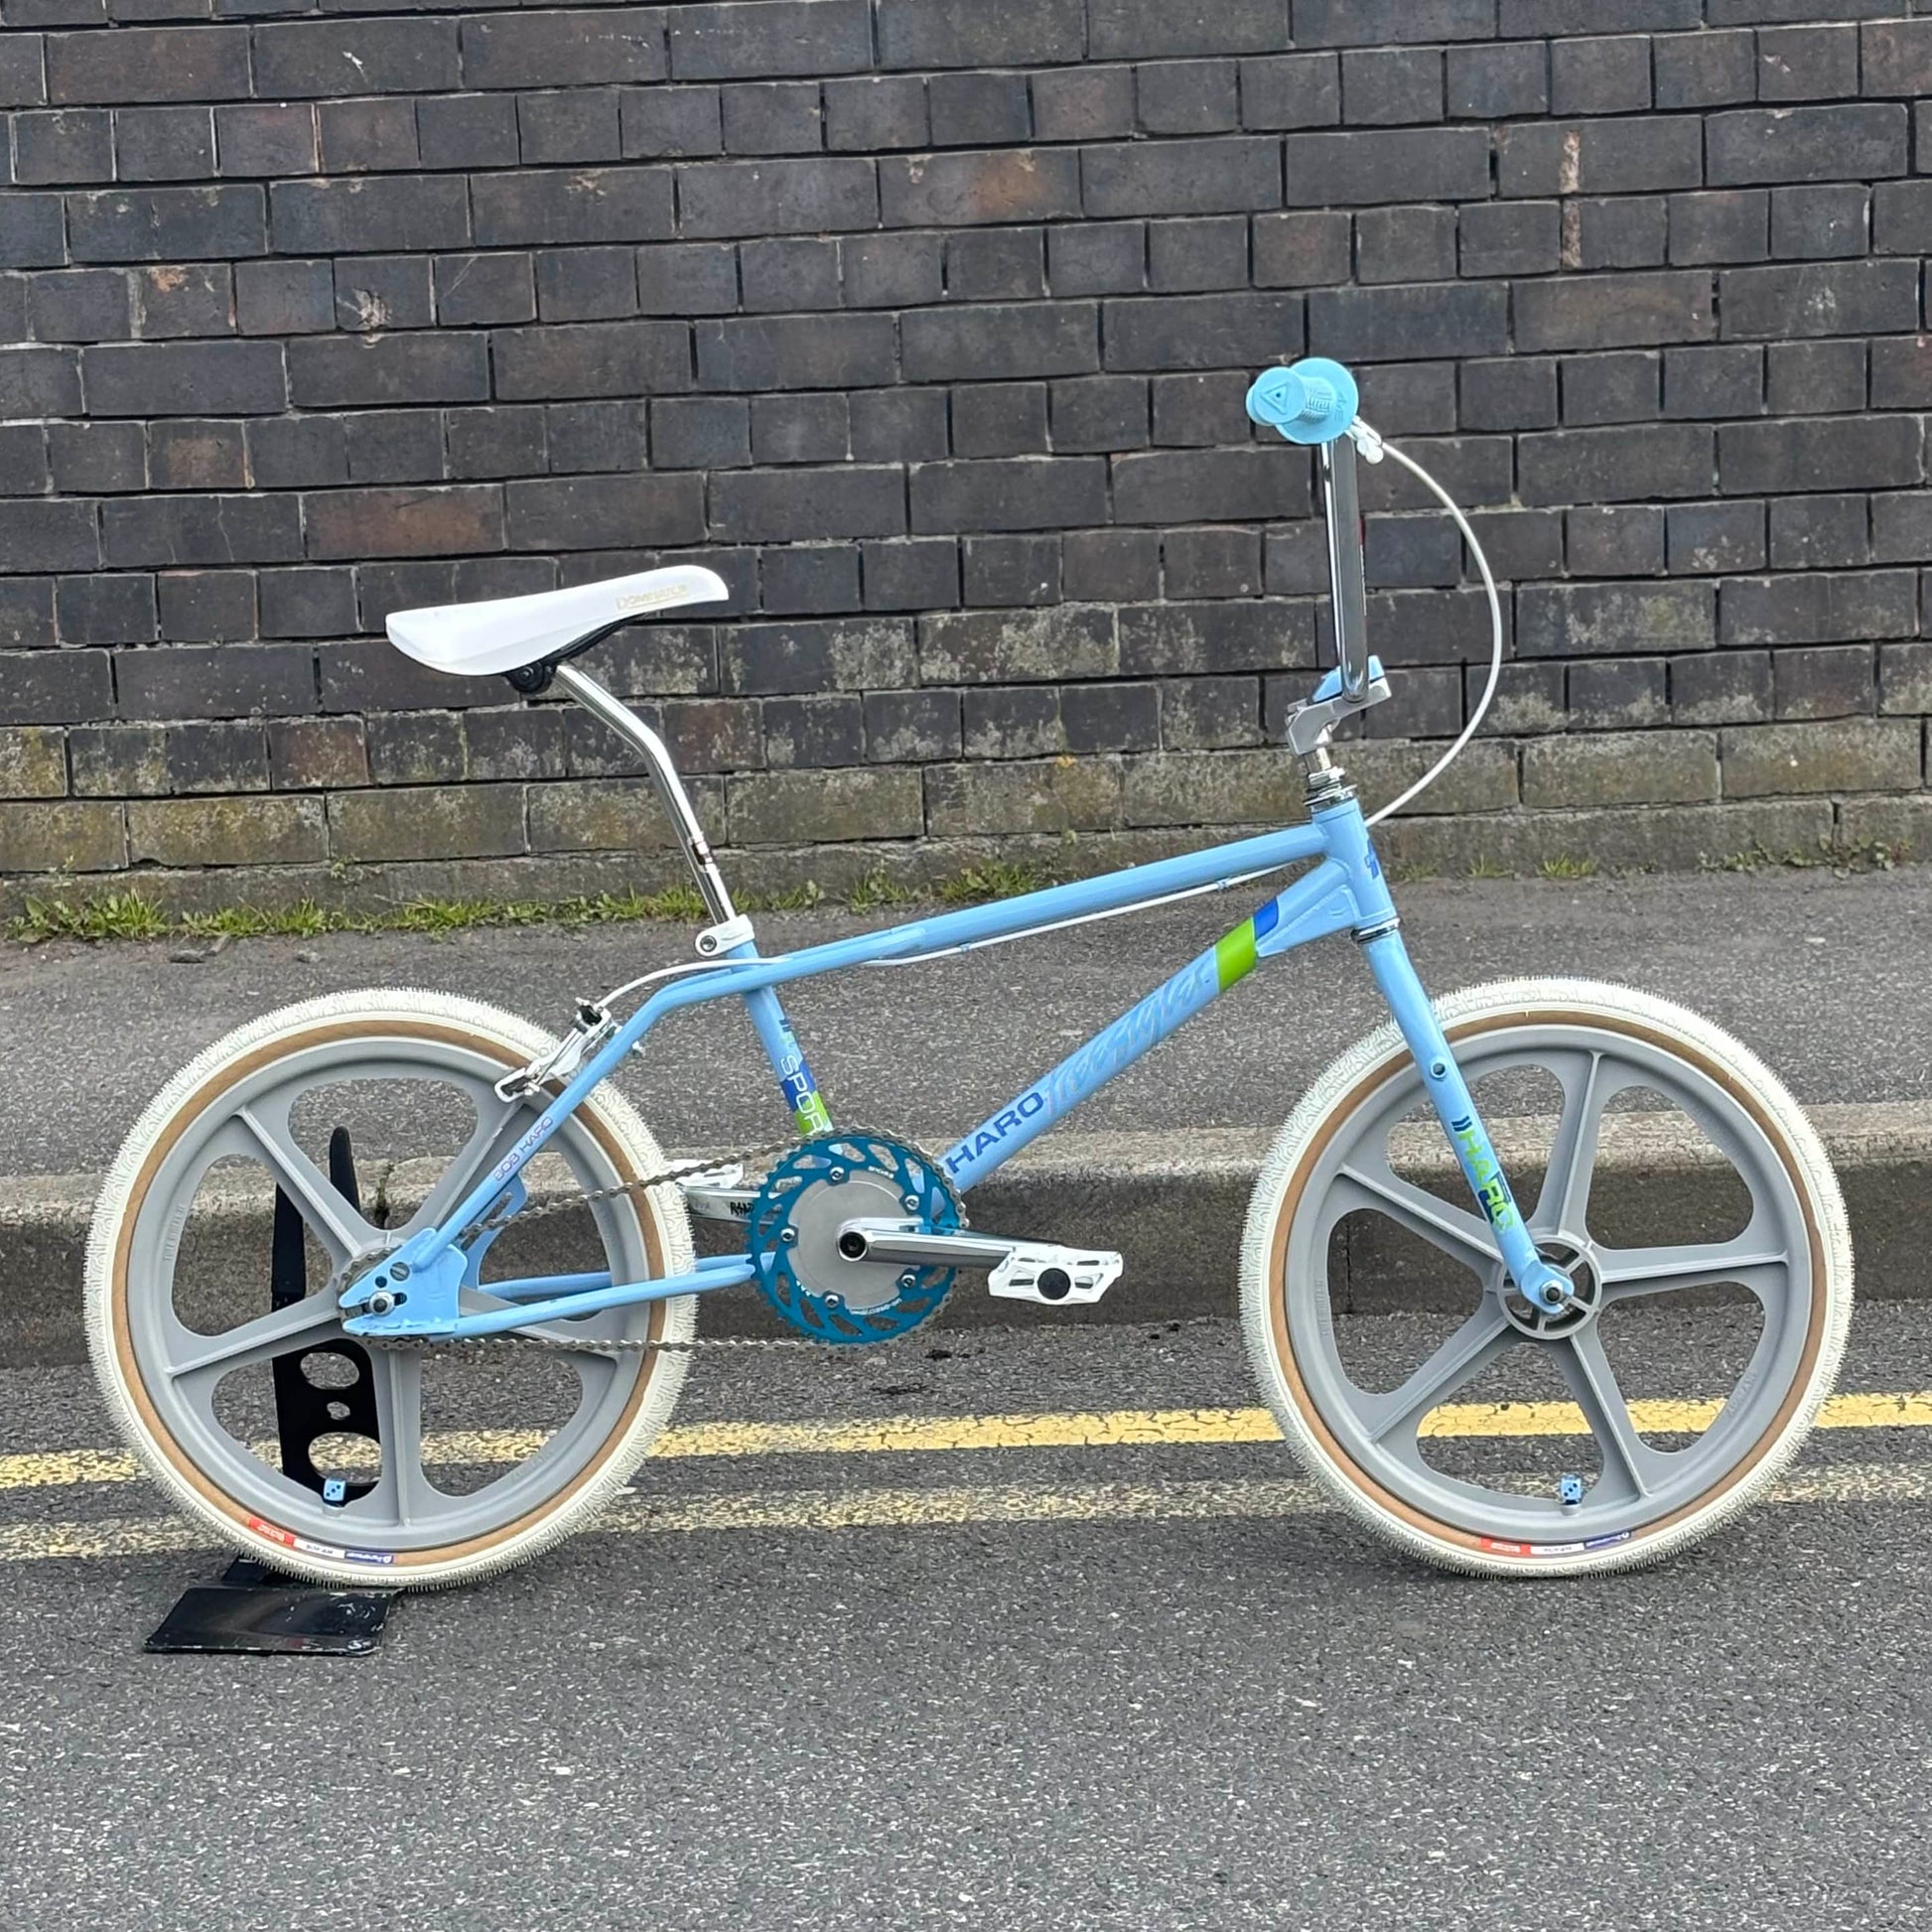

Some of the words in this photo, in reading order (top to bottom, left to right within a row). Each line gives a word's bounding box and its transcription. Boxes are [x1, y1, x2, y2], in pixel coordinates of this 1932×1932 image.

[493, 1153, 520, 1181] BOB
[519, 1116, 553, 1153] HARO
[945, 1092, 1043, 1173] HARO
[1457, 1131, 1513, 1231] HARO
